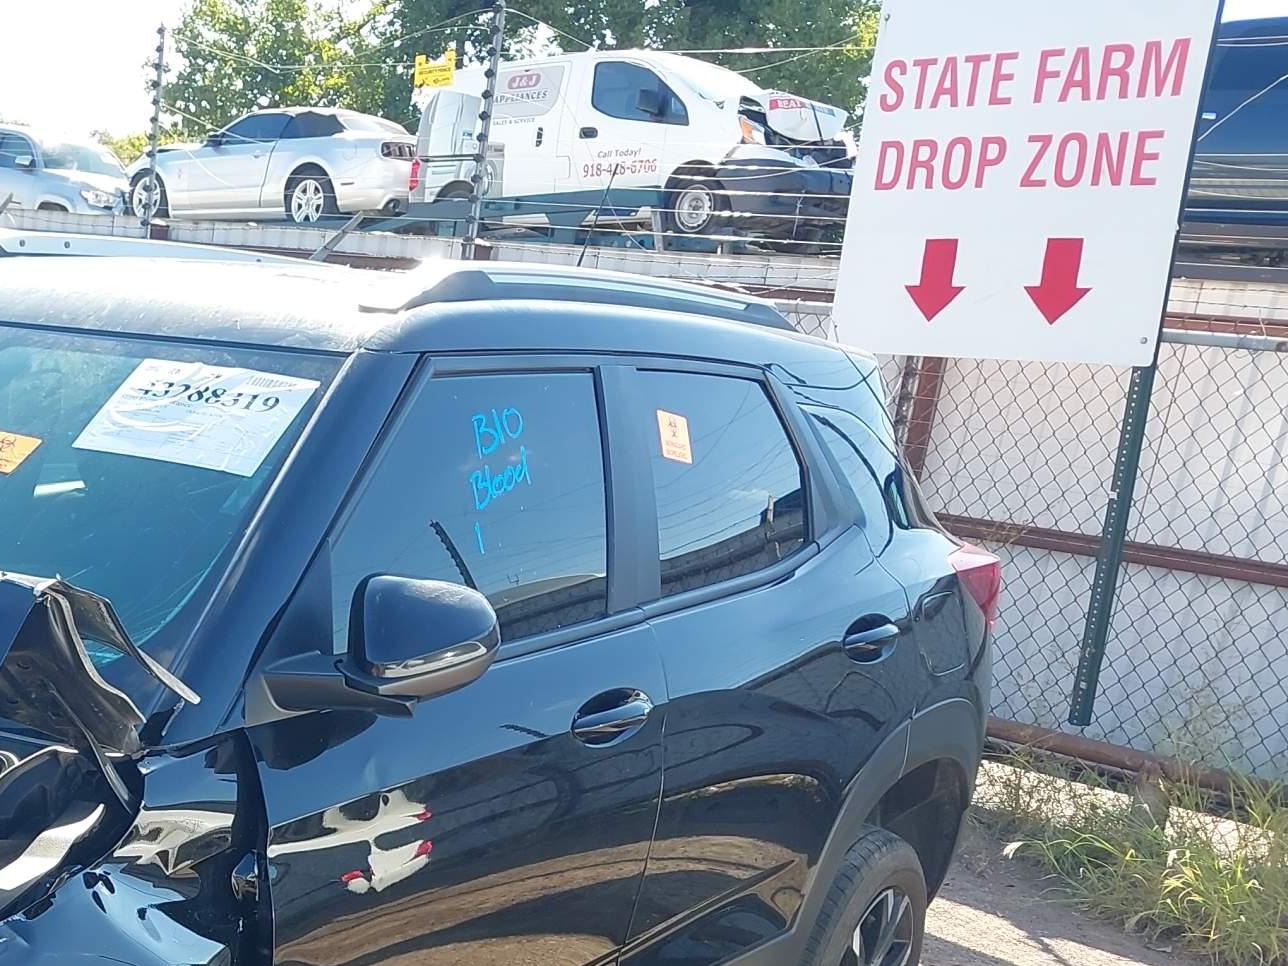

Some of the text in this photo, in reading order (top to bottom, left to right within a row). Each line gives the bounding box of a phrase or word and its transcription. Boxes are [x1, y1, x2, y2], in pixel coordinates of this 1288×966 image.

[879, 37, 1191, 112] STATE FARM
[874, 131, 1164, 191] DROP ZONE
[470, 446, 532, 510] Blood
